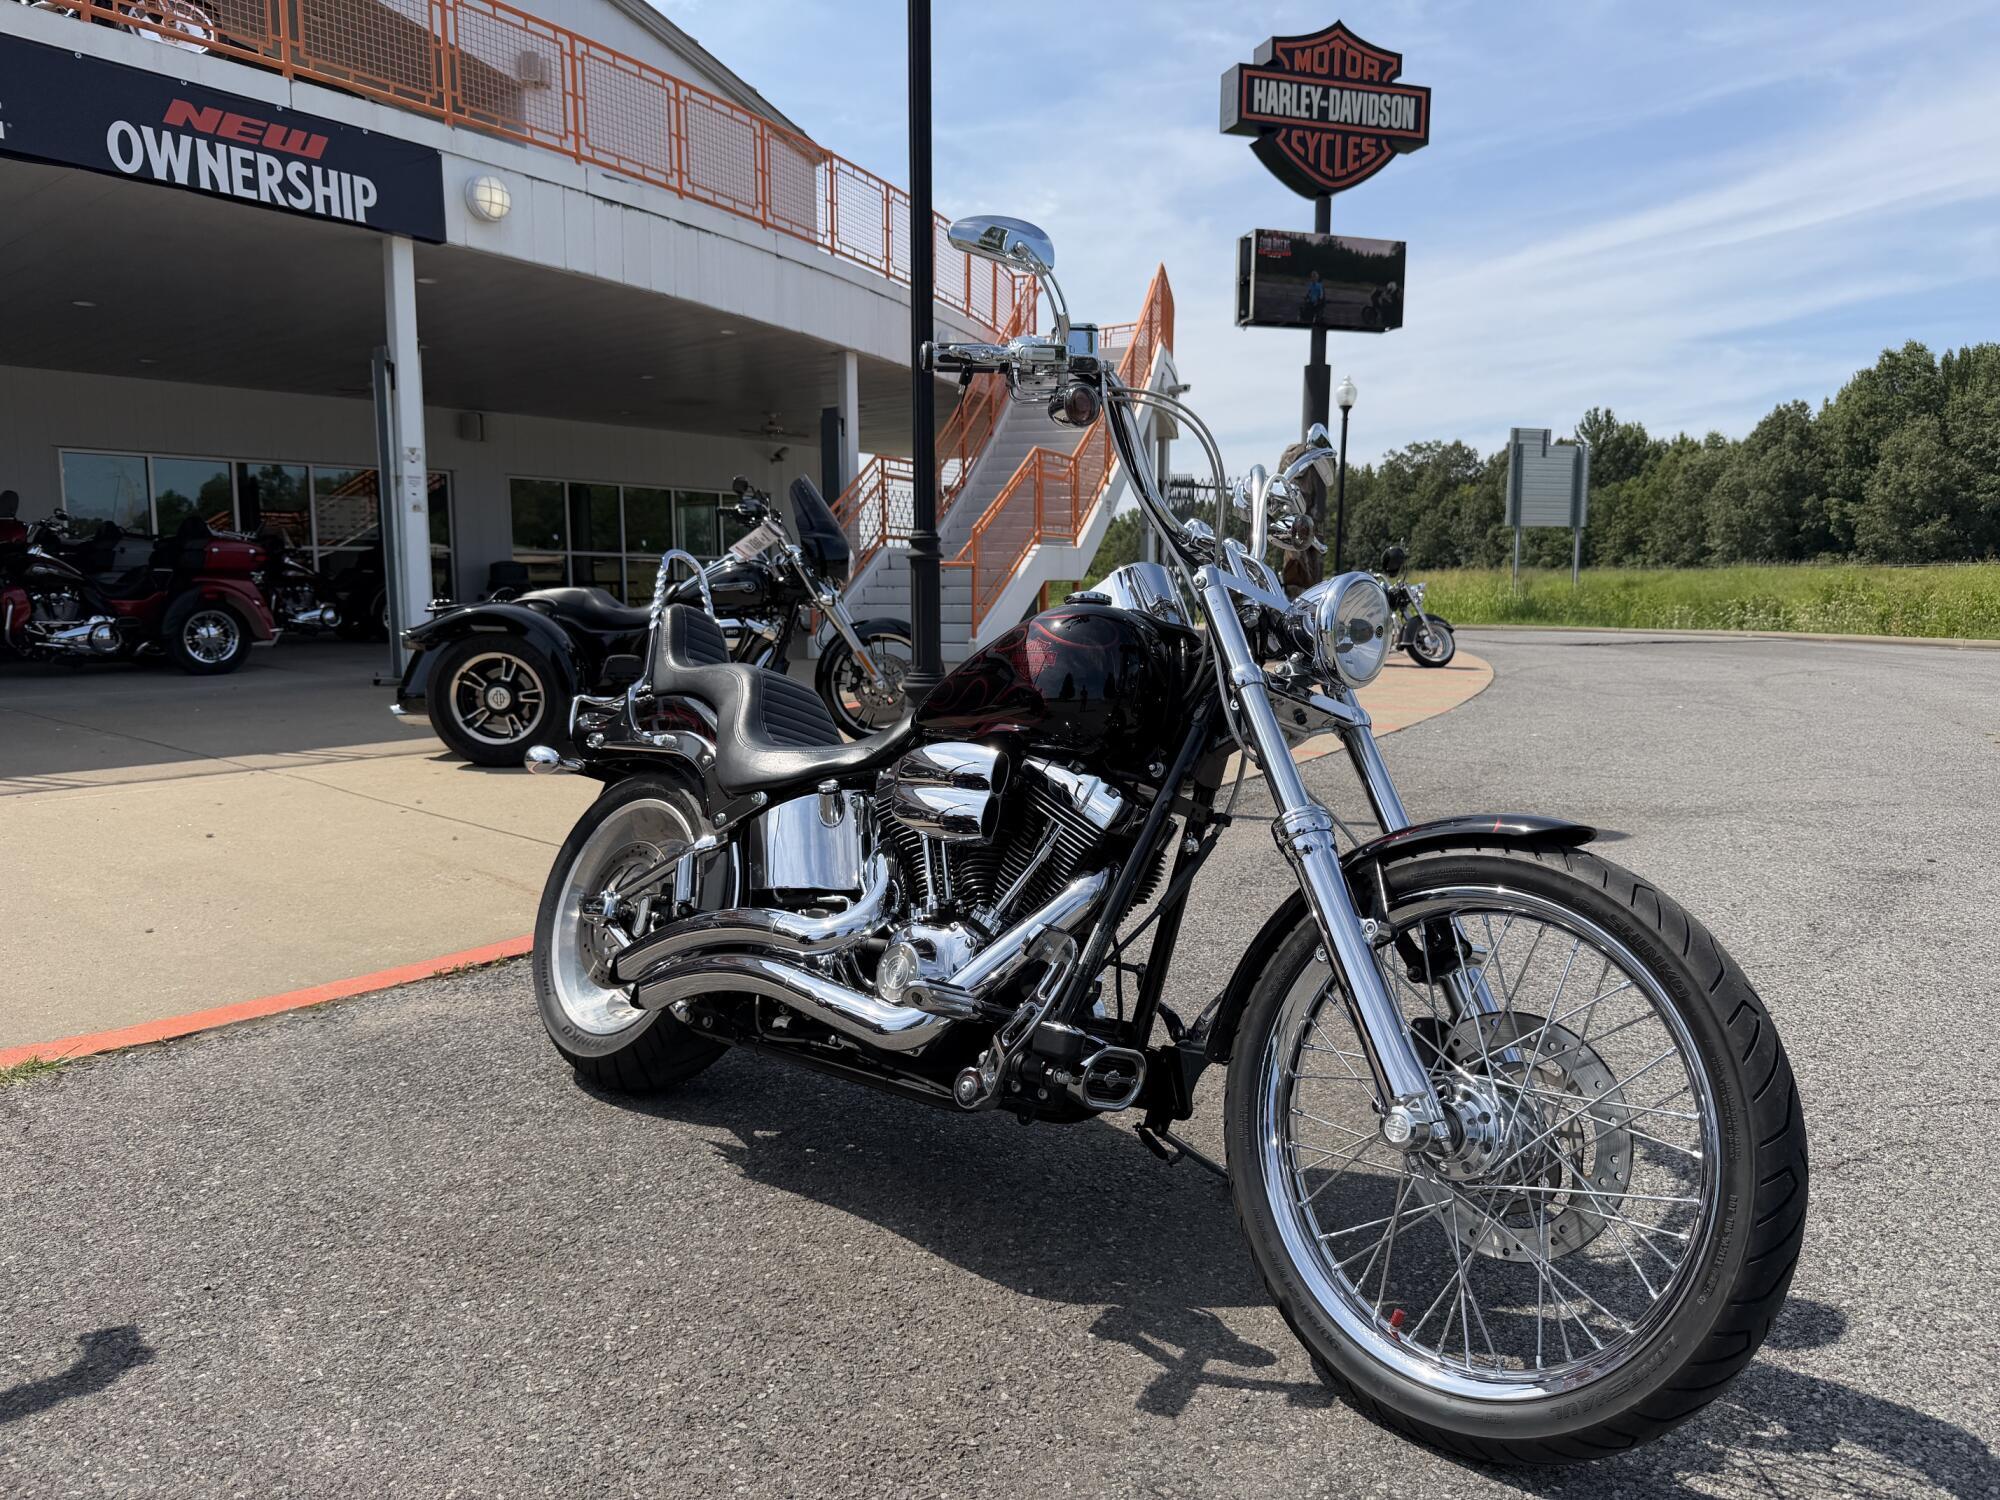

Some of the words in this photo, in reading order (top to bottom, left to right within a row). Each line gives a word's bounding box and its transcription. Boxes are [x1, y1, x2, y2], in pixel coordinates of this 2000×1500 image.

[1293, 37, 1380, 82] MOTOR
[163, 98, 329, 160] NEW
[1253, 78, 1416, 130] HARLEY-DAVIDSON
[106, 120, 378, 223] OWNERSHIP
[1291, 130, 1377, 178] CYCLES
